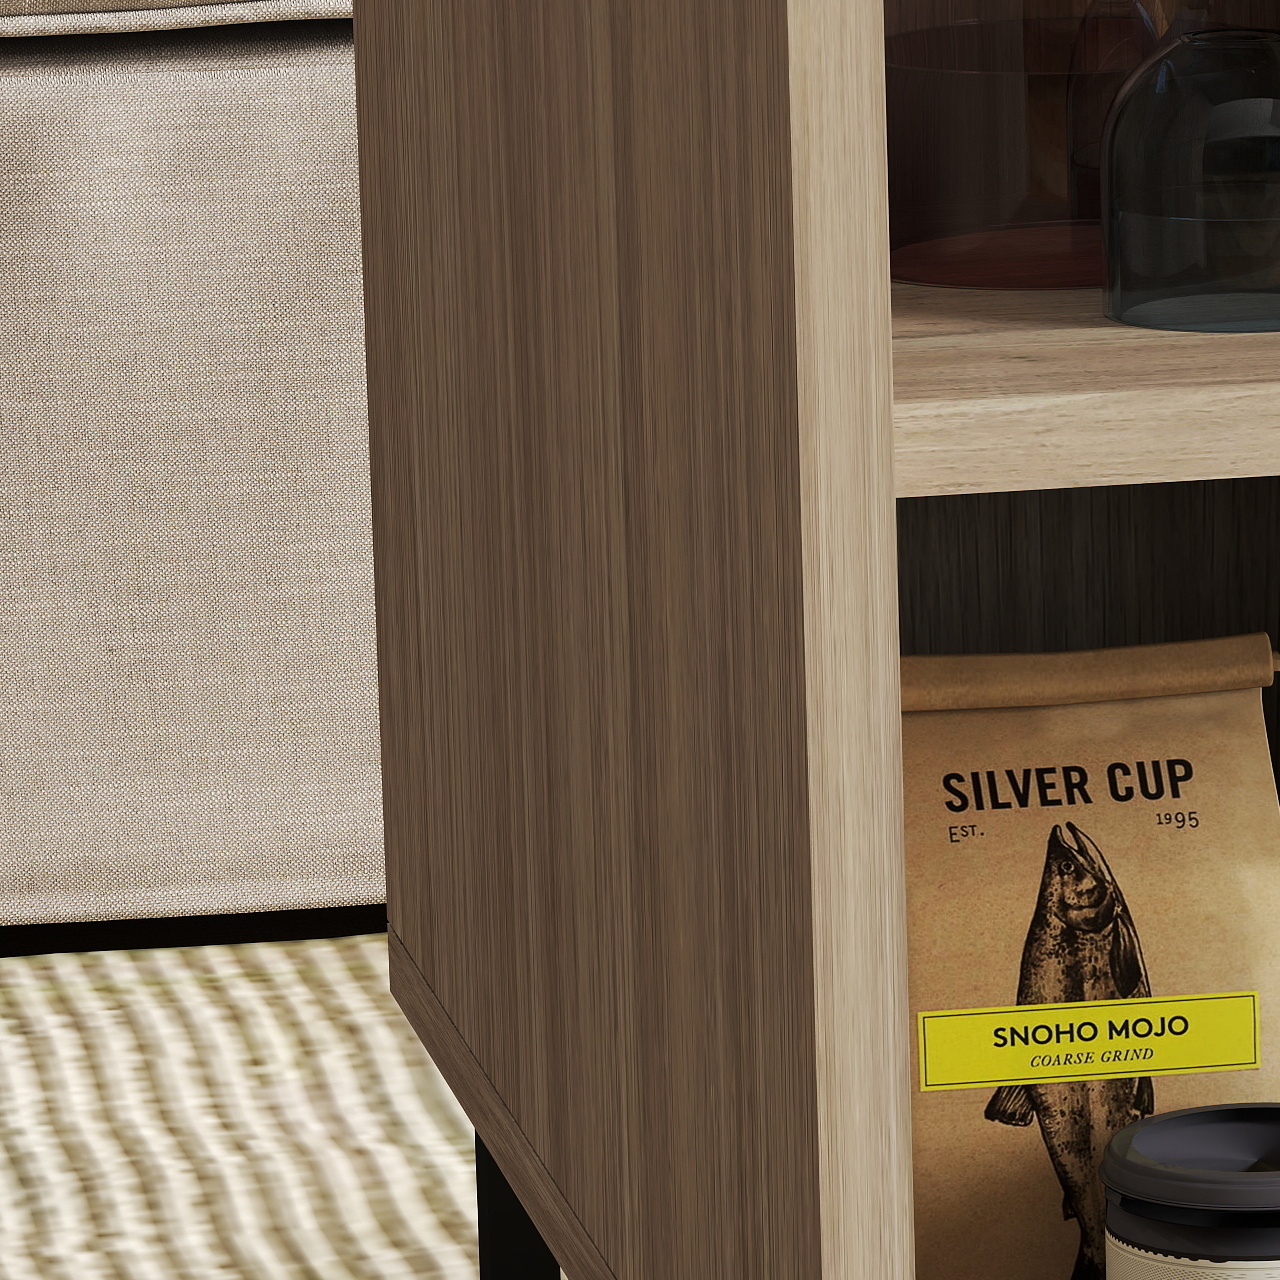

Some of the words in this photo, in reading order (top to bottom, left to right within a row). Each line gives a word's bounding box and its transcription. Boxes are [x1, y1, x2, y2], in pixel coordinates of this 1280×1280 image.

[942, 765, 1092, 813] SILVER
[1106, 758, 1193, 801] CUP
[949, 824, 984, 843] EST.
[1157, 812, 1199, 829] 1995
[993, 1021, 1098, 1046] SNOHO
[1108, 1016, 1189, 1040] MOJO
[1030, 1051, 1096, 1068] COARSE
[1101, 1047, 1154, 1063] GRIND
